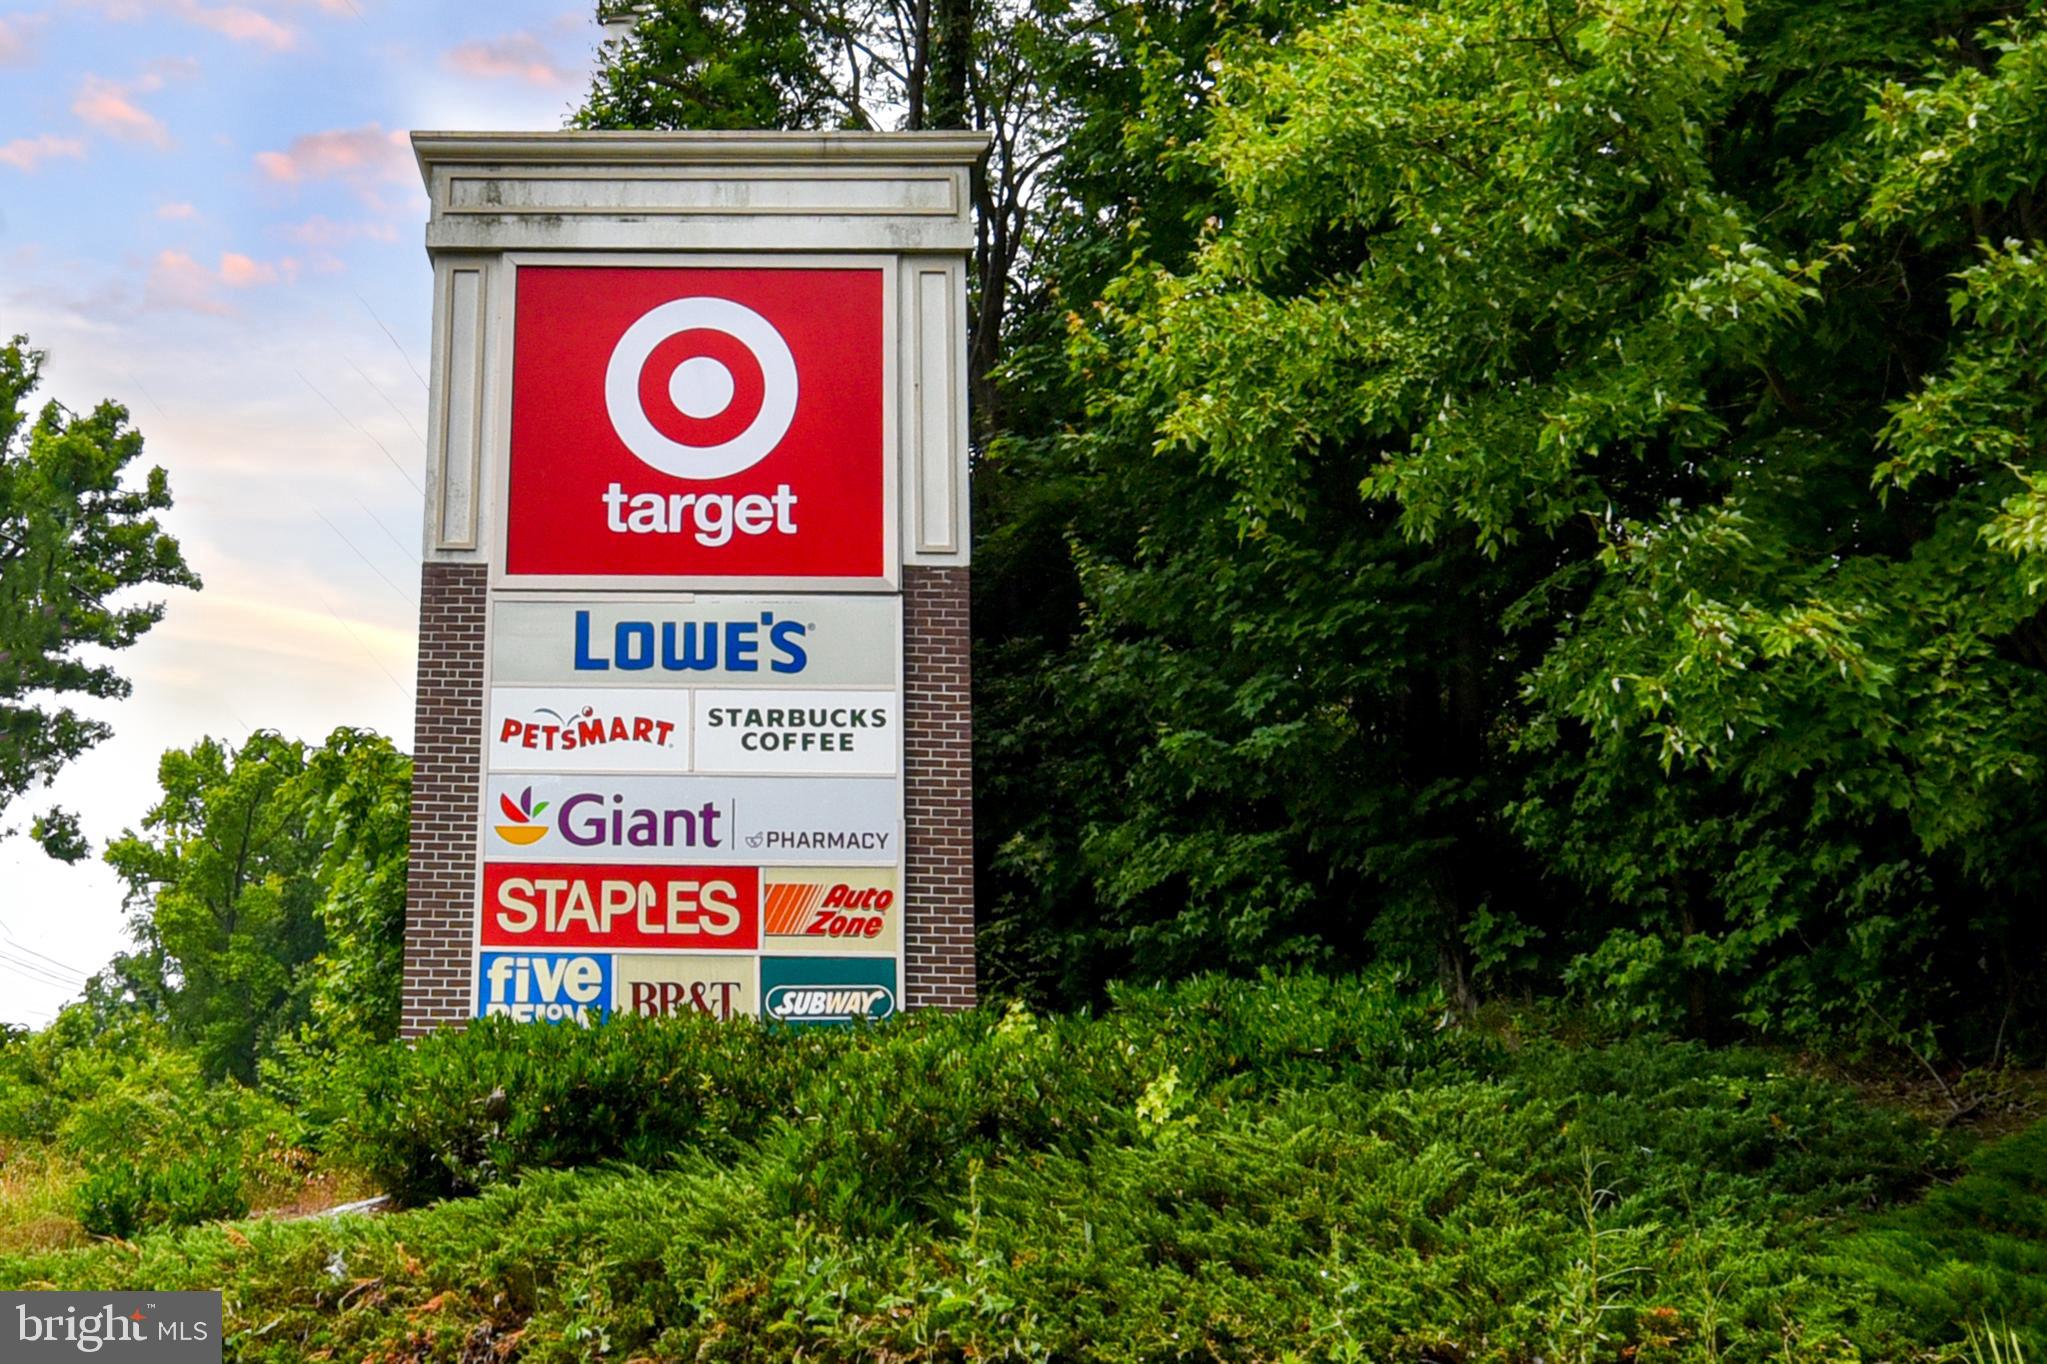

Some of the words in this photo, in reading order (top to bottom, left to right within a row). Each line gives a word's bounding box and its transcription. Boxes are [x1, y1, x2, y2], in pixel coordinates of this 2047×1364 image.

[602, 483, 798, 547] target
[708, 708, 887, 729] STARBUCKS
[741, 732, 854, 752] COFFEE
[557, 793, 722, 848] Giant
[766, 831, 890, 850] PHARMACY
[496, 877, 741, 936] STAPLES
[821, 883, 894, 912] Auto
[805, 911, 885, 938] Zone
[487, 956, 603, 1003] five
[774, 991, 886, 1015] SUBWAY
